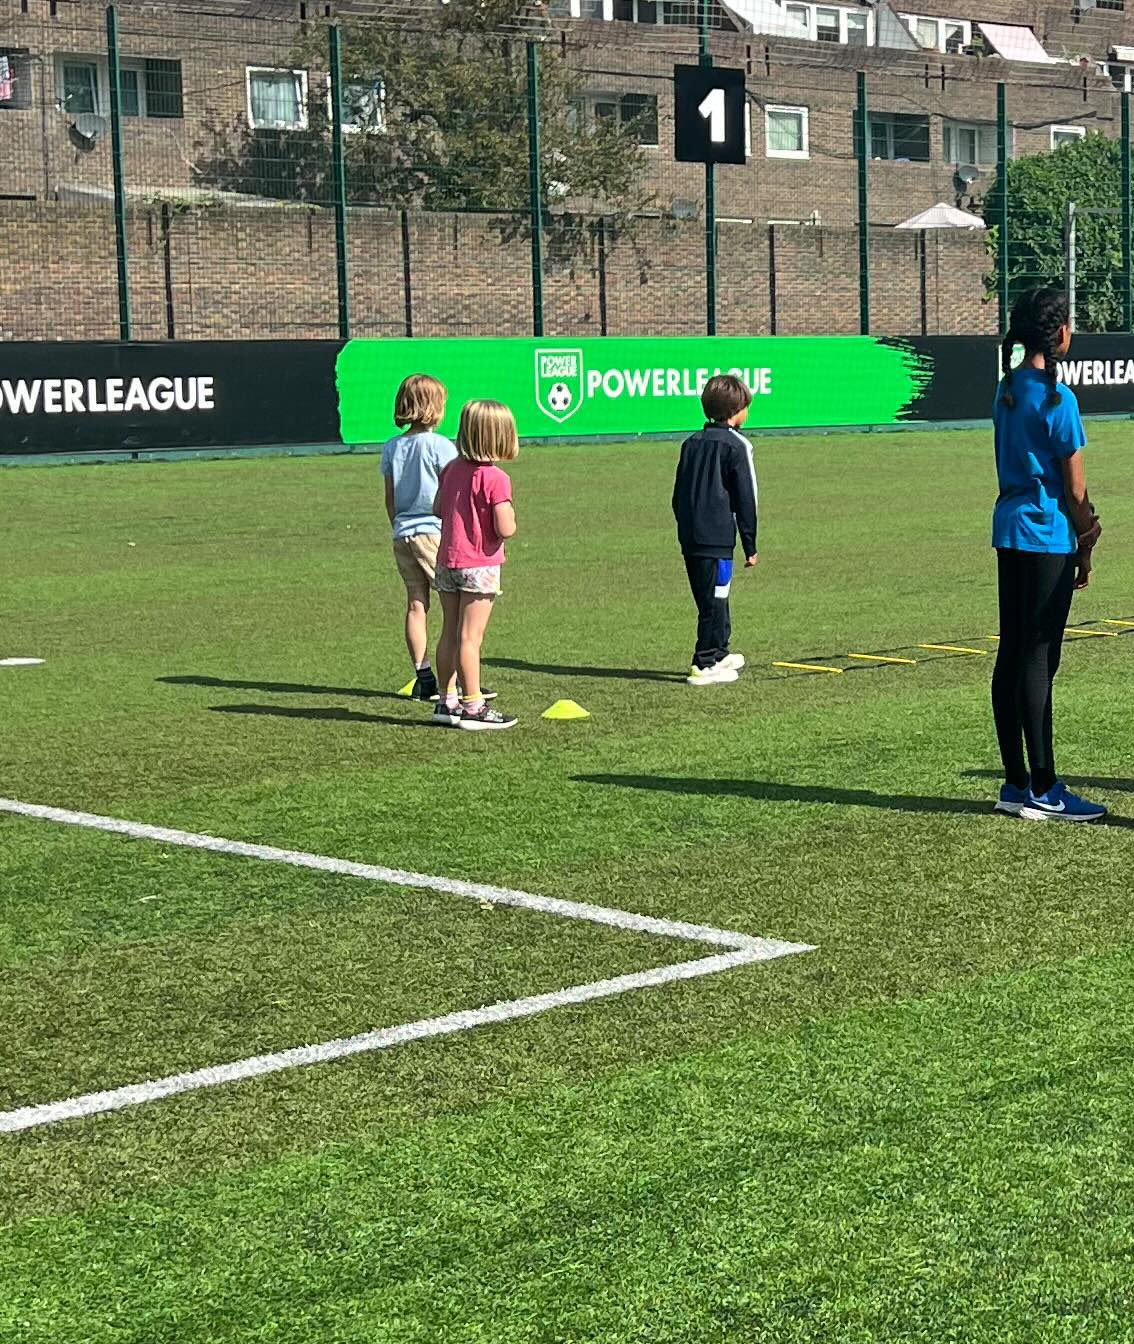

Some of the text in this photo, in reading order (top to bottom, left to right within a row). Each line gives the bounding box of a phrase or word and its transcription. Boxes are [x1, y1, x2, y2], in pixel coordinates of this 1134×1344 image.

[698, 88, 725, 142] 1
[541, 355, 577, 367] POWER
[541, 364, 578, 378] LEAGUE
[0, 377, 215, 414] WERLEAGUE
[587, 367, 772, 399] POWERLEUE
